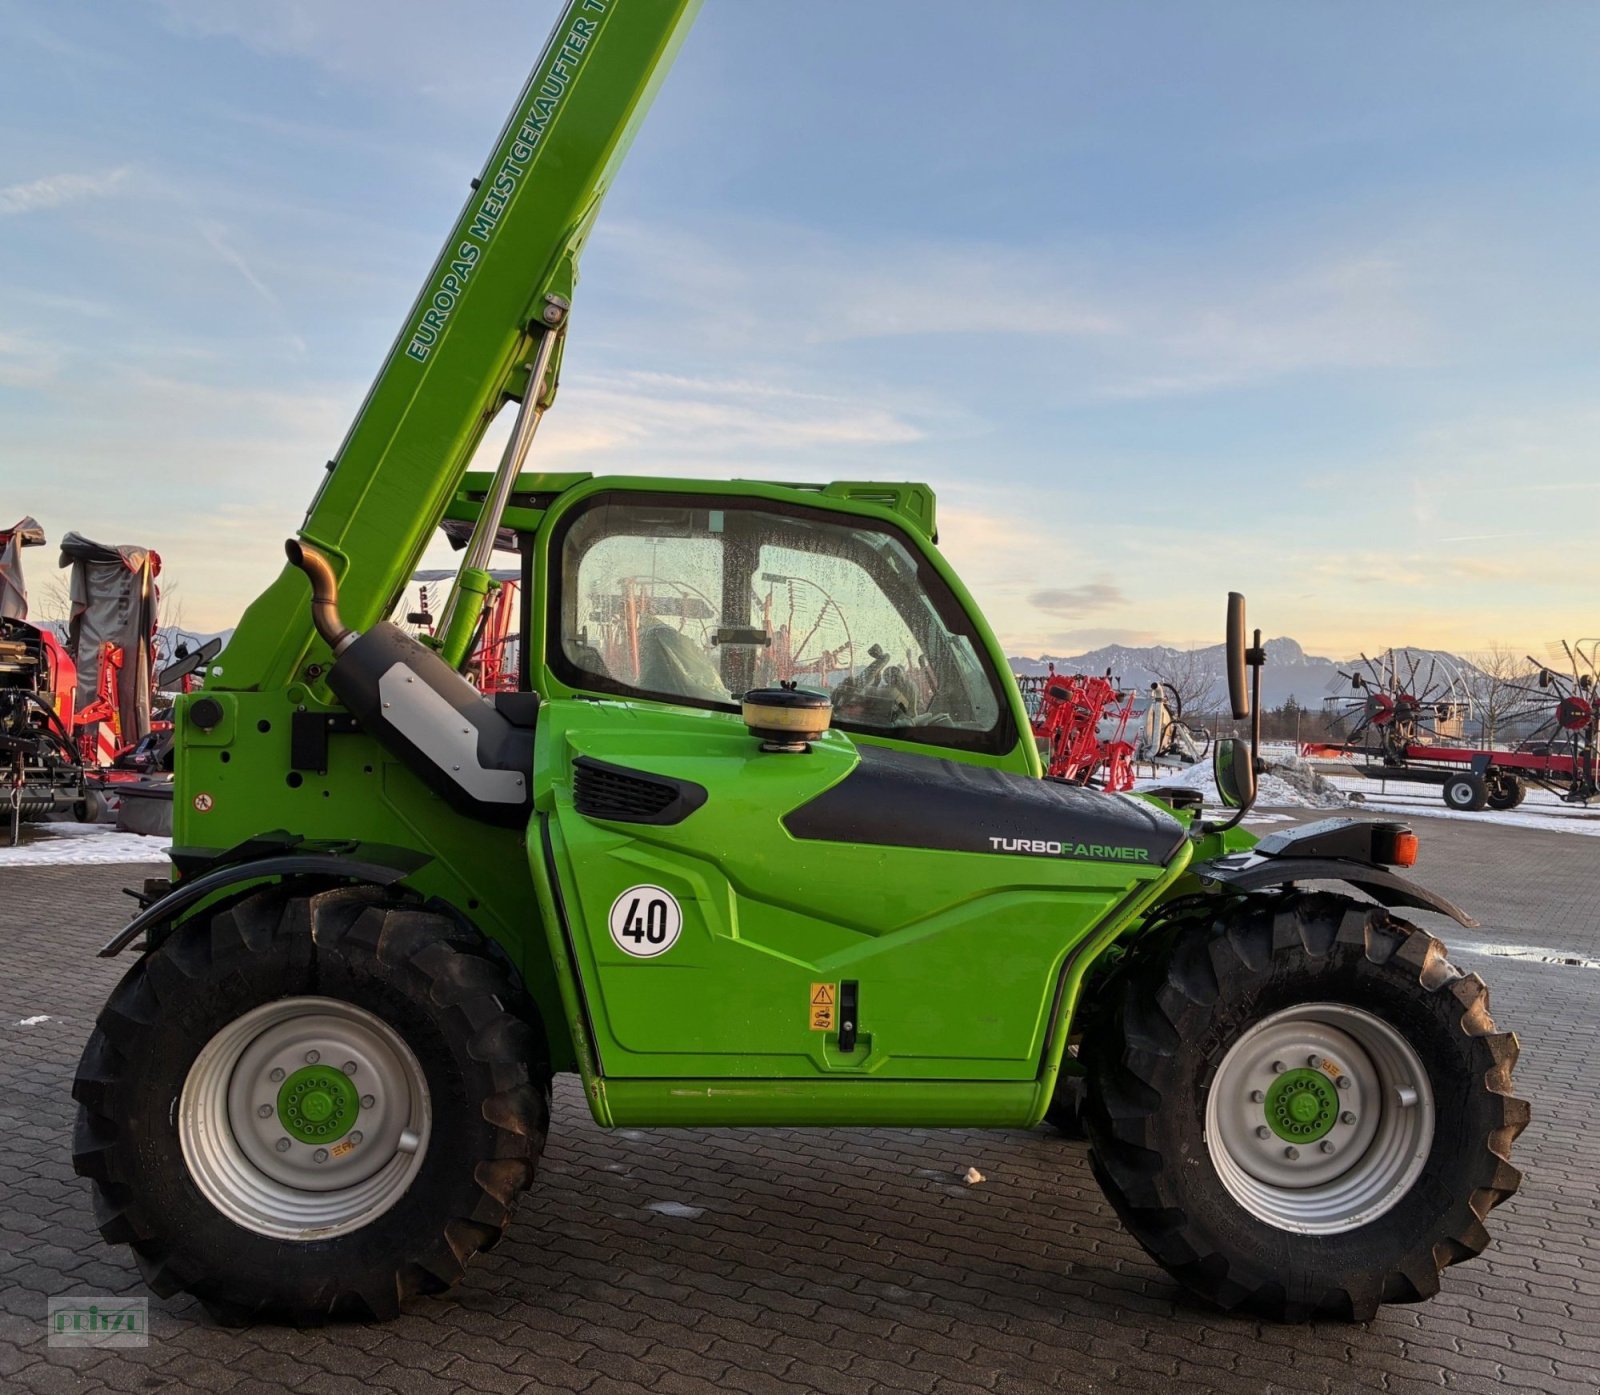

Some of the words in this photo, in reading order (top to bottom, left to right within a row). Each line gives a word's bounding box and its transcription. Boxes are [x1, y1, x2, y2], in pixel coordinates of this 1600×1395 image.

[405, 241, 480, 363] EUROPAS
[469, 17, 598, 242] MEISTGEKAUFTER
[989, 837, 1148, 860] TURBOFARMER
[622, 898, 667, 943] 40
